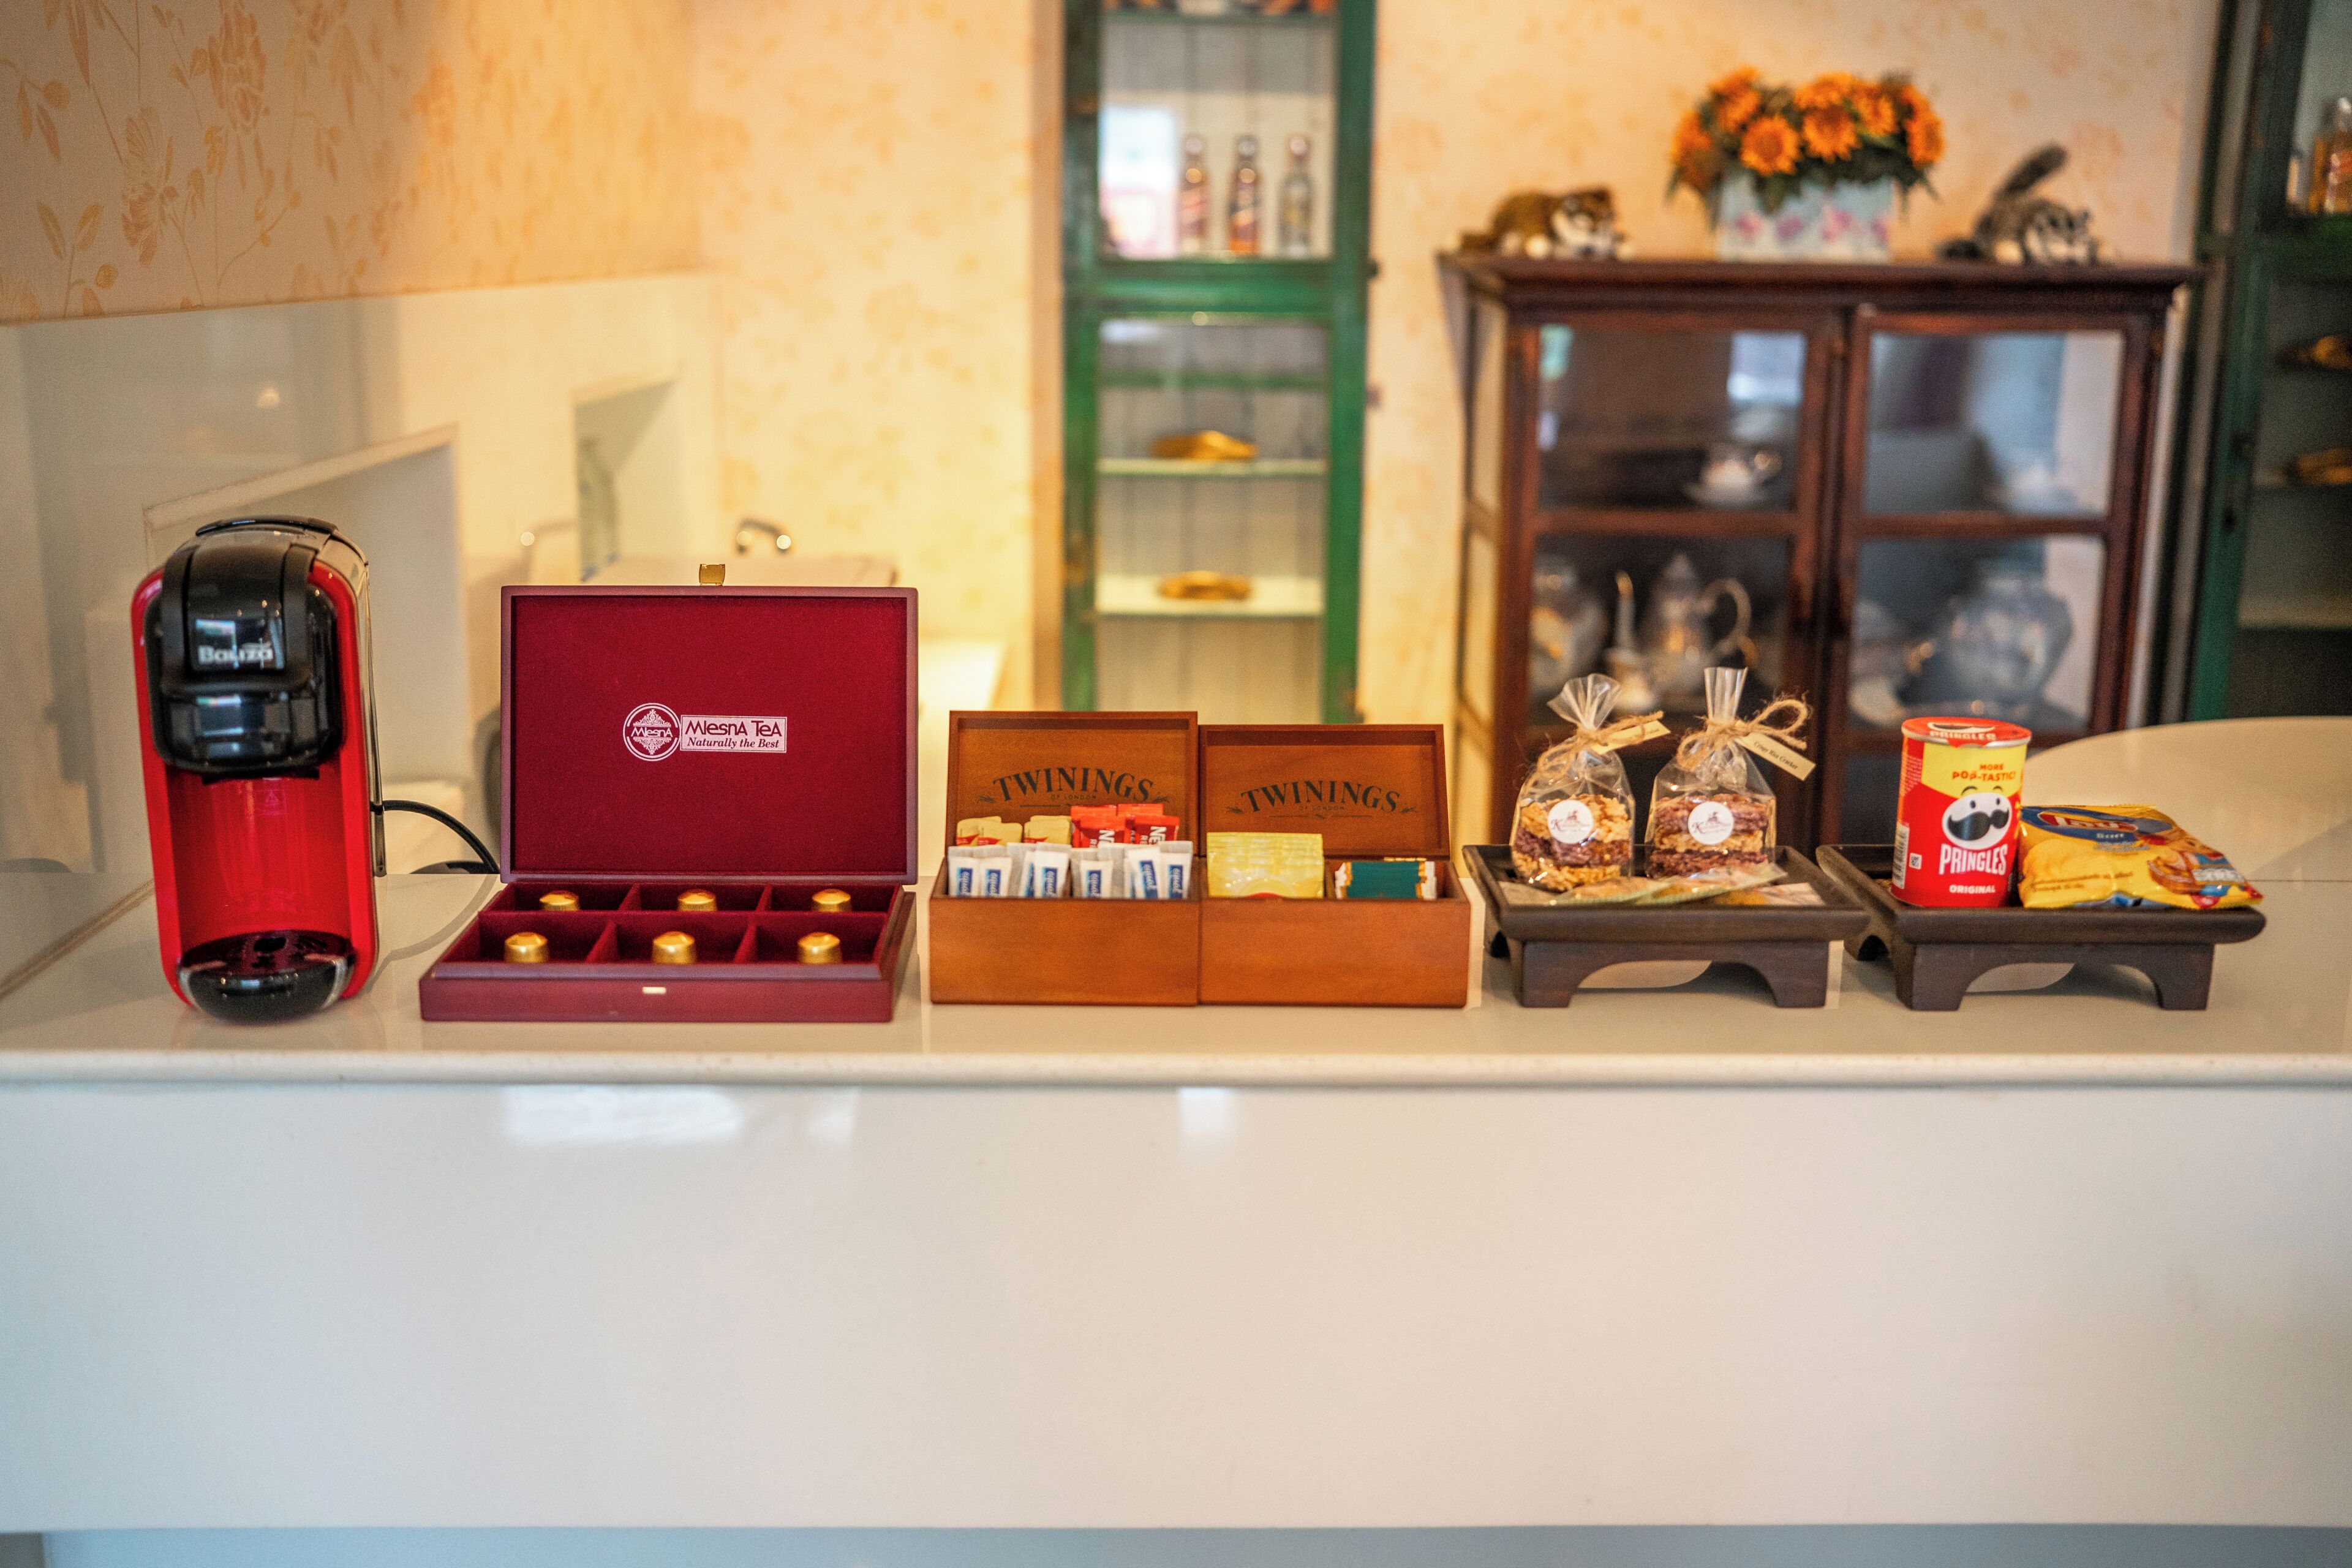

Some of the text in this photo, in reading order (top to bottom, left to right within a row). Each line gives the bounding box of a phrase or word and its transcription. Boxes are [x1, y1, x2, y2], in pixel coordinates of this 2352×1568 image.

[687, 737, 780, 749] Naturally the Best
[993, 766, 1154, 803] TWININGS
[1240, 779, 1401, 813] TWININGS
[1939, 843, 2008, 876] PRINGLES
[1949, 884, 1996, 894] ORIGINAL
